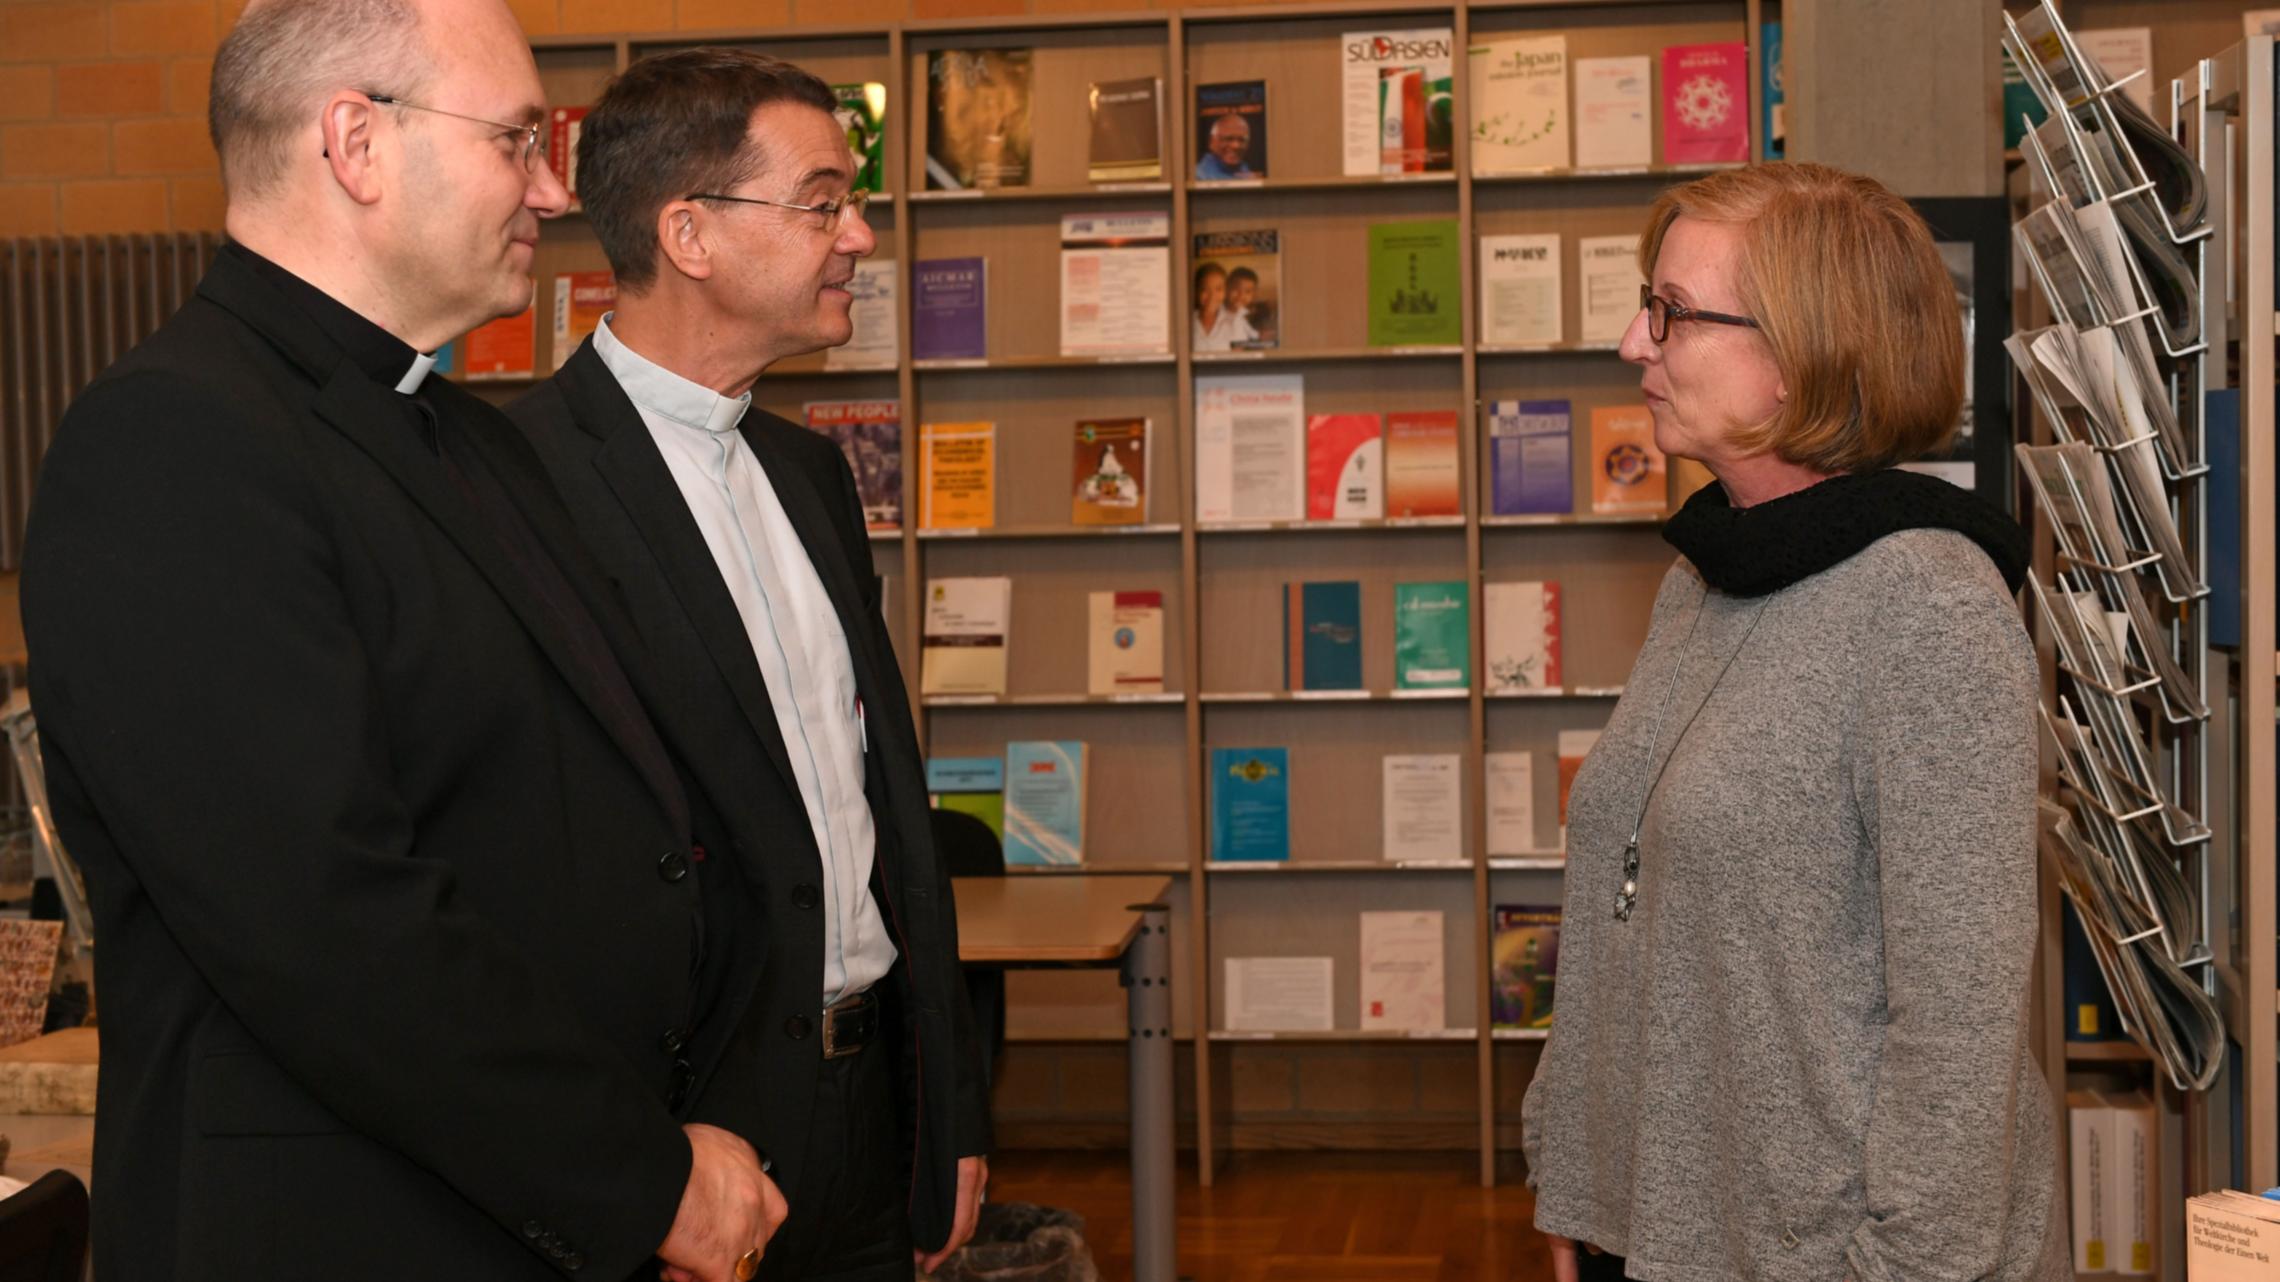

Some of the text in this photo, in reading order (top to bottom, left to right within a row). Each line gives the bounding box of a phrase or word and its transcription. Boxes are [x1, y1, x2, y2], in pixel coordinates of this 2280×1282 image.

[1515, 51, 1562, 69] Japan
[813, 402, 899, 420] NEW PEOPLE
[2207, 1217, 2259, 1237] Spezialbibliothek
[2204, 1228, 2236, 1243] Weltkirche
[2237, 1238, 2250, 1247] und
[2194, 1236, 2223, 1252] Theologie
[2224, 1245, 2236, 1255] der
[2236, 1248, 2255, 1259] Einen
